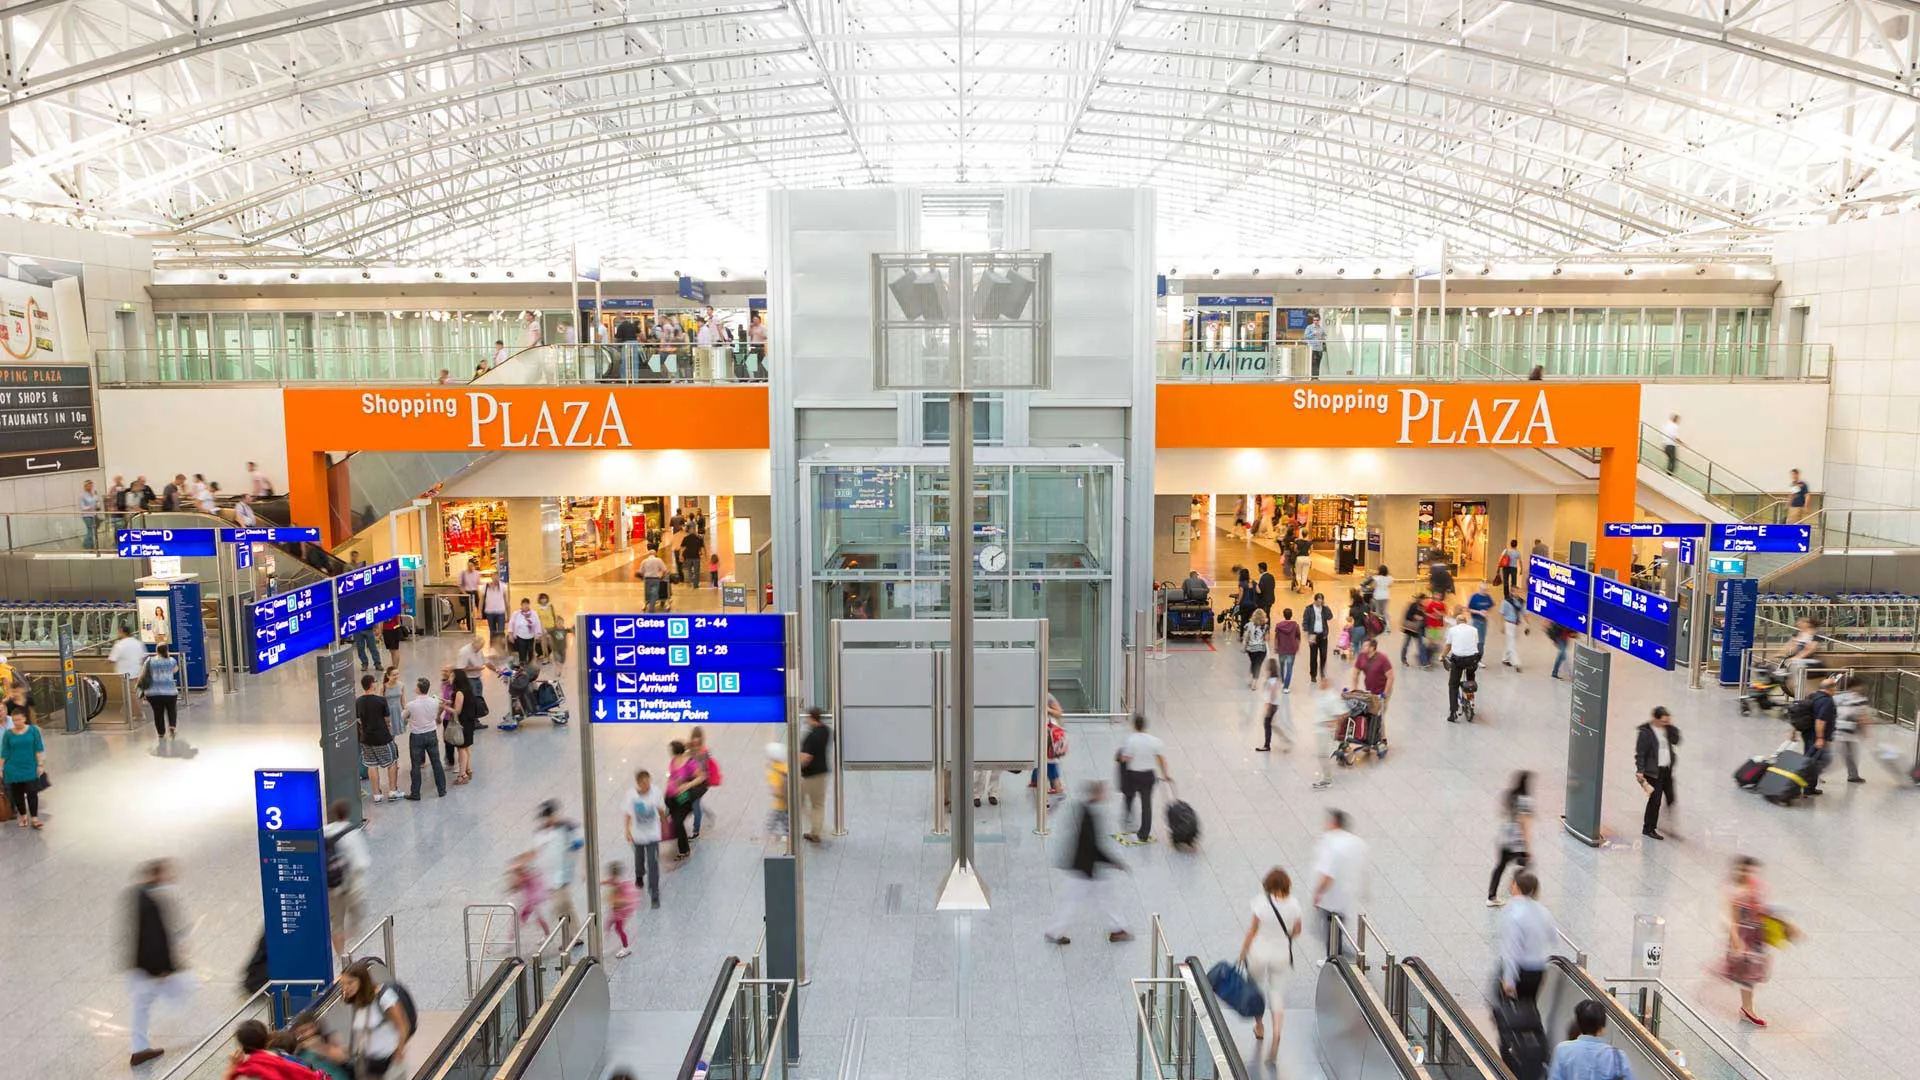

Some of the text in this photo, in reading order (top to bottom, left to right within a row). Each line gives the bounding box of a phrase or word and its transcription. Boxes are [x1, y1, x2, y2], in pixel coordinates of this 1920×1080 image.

[33, 370, 62, 382] PLAZA
[18, 392, 47, 404] SHOPS
[52, 391, 59, 403] &
[0, 411, 87, 426] TAURANTS IN 10m
[362, 391, 632, 448] Shopping PLAZA
[1293, 388, 1559, 445] Shopping PLAZA
[163, 530, 173, 541] D
[267, 528, 276, 540] E
[1652, 524, 1663, 536] D
[1758, 525, 1767, 537] E
[636, 618, 665, 628] Gates
[637, 645, 666, 655] Gates
[639, 672, 679, 682] Ankunft
[639, 683, 677, 693] Arrivals
[639, 699, 691, 710] Treffpunkt
[639, 709, 709, 721] Meeting Point
[265, 806, 282, 830] 3
